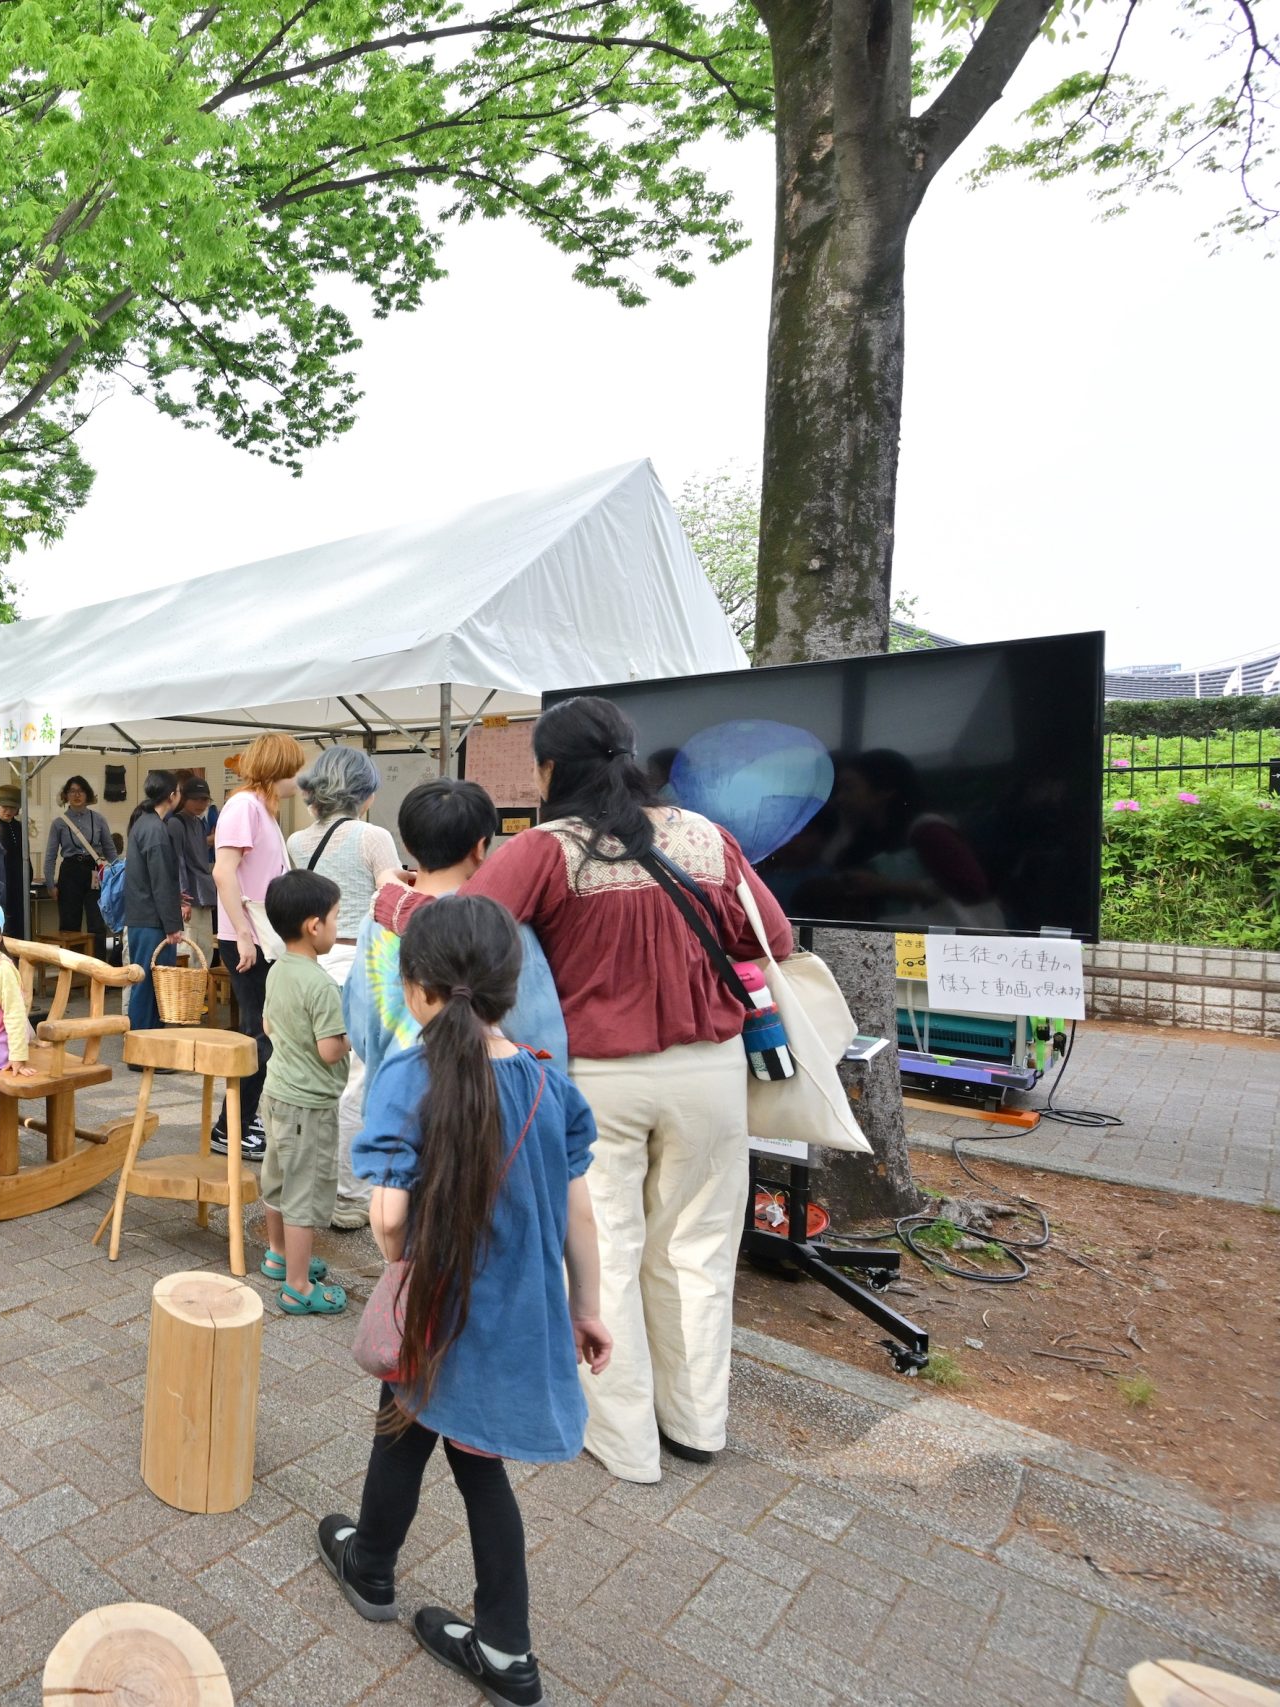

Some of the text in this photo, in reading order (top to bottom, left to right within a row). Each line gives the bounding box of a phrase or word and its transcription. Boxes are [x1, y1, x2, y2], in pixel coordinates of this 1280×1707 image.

[942, 943, 1071, 972] 生徒の活動の
